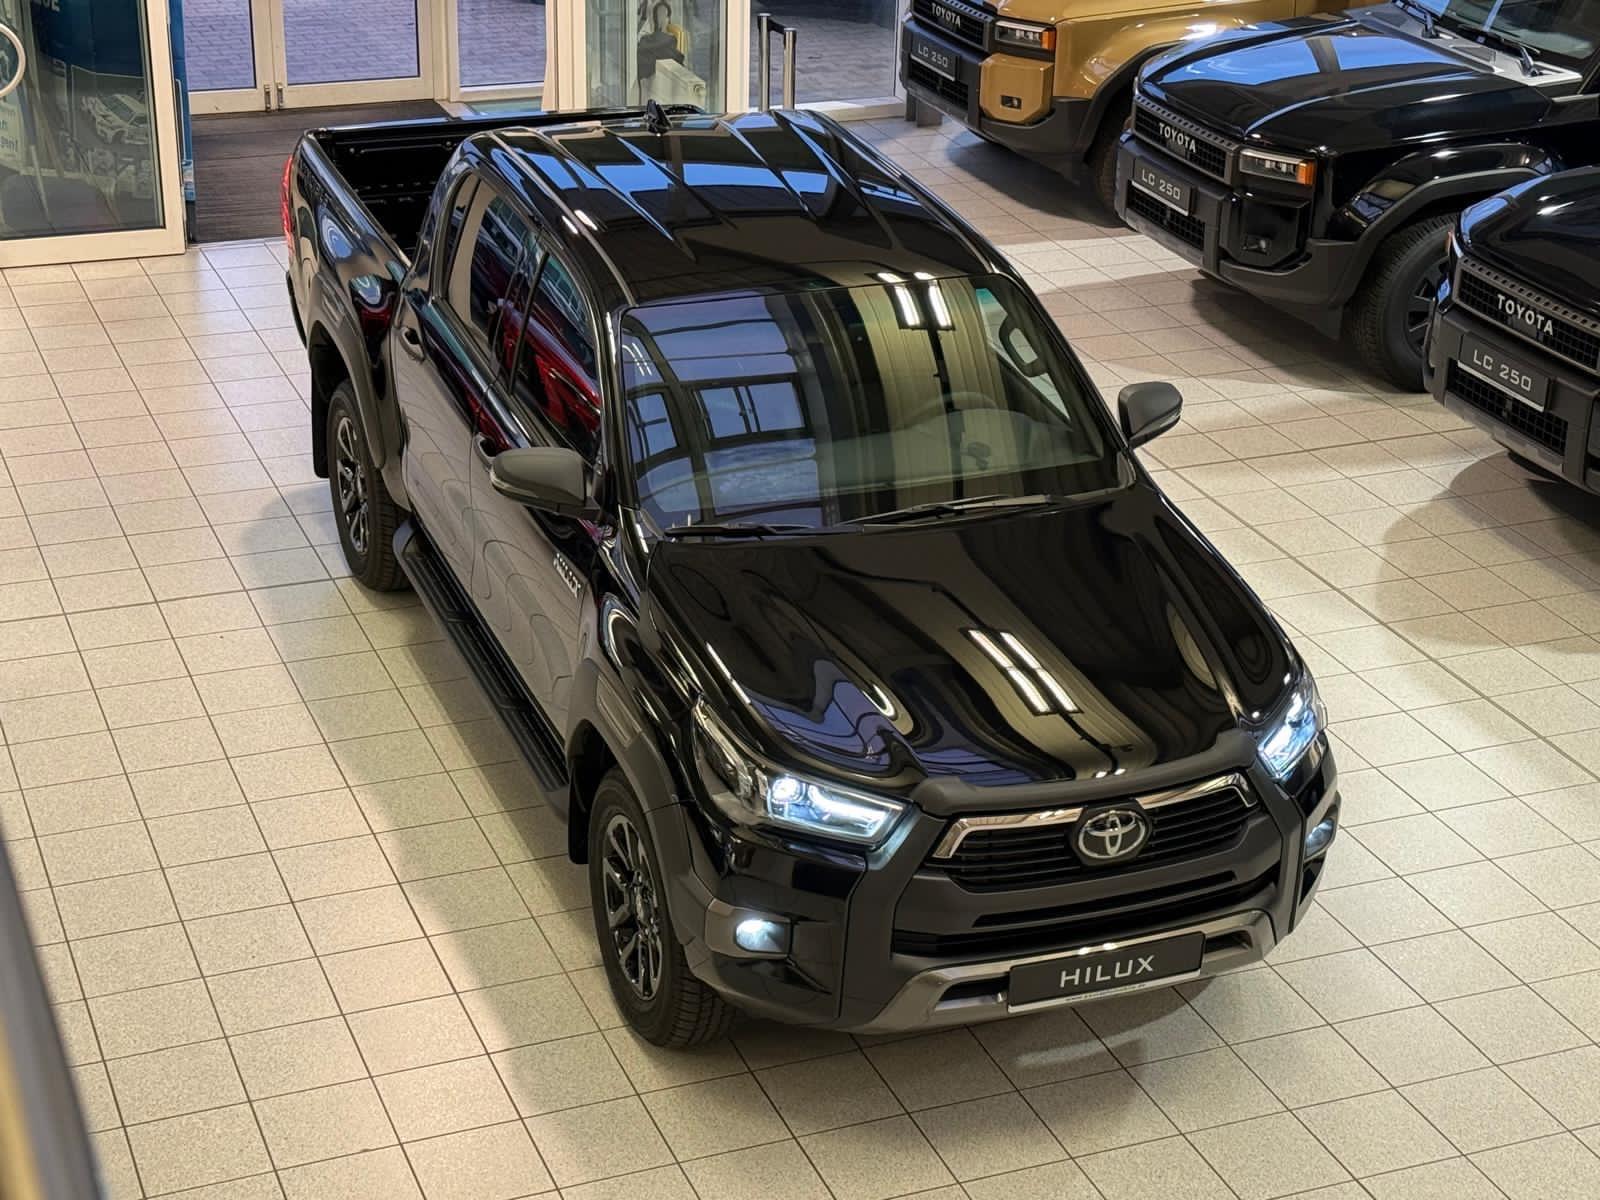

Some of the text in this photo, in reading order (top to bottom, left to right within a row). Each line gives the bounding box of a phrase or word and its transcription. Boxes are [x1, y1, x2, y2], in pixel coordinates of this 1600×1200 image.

[931, 2, 961, 28] TOYOTA
[917, 43, 948, 68] LC 250
[1159, 122, 1196, 153] TOYOTA
[1142, 169, 1180, 200] LC 250
[1497, 293, 1553, 336] TOYOTA
[1473, 349, 1532, 392] LC 250
[1060, 955, 1154, 988] HILUX
